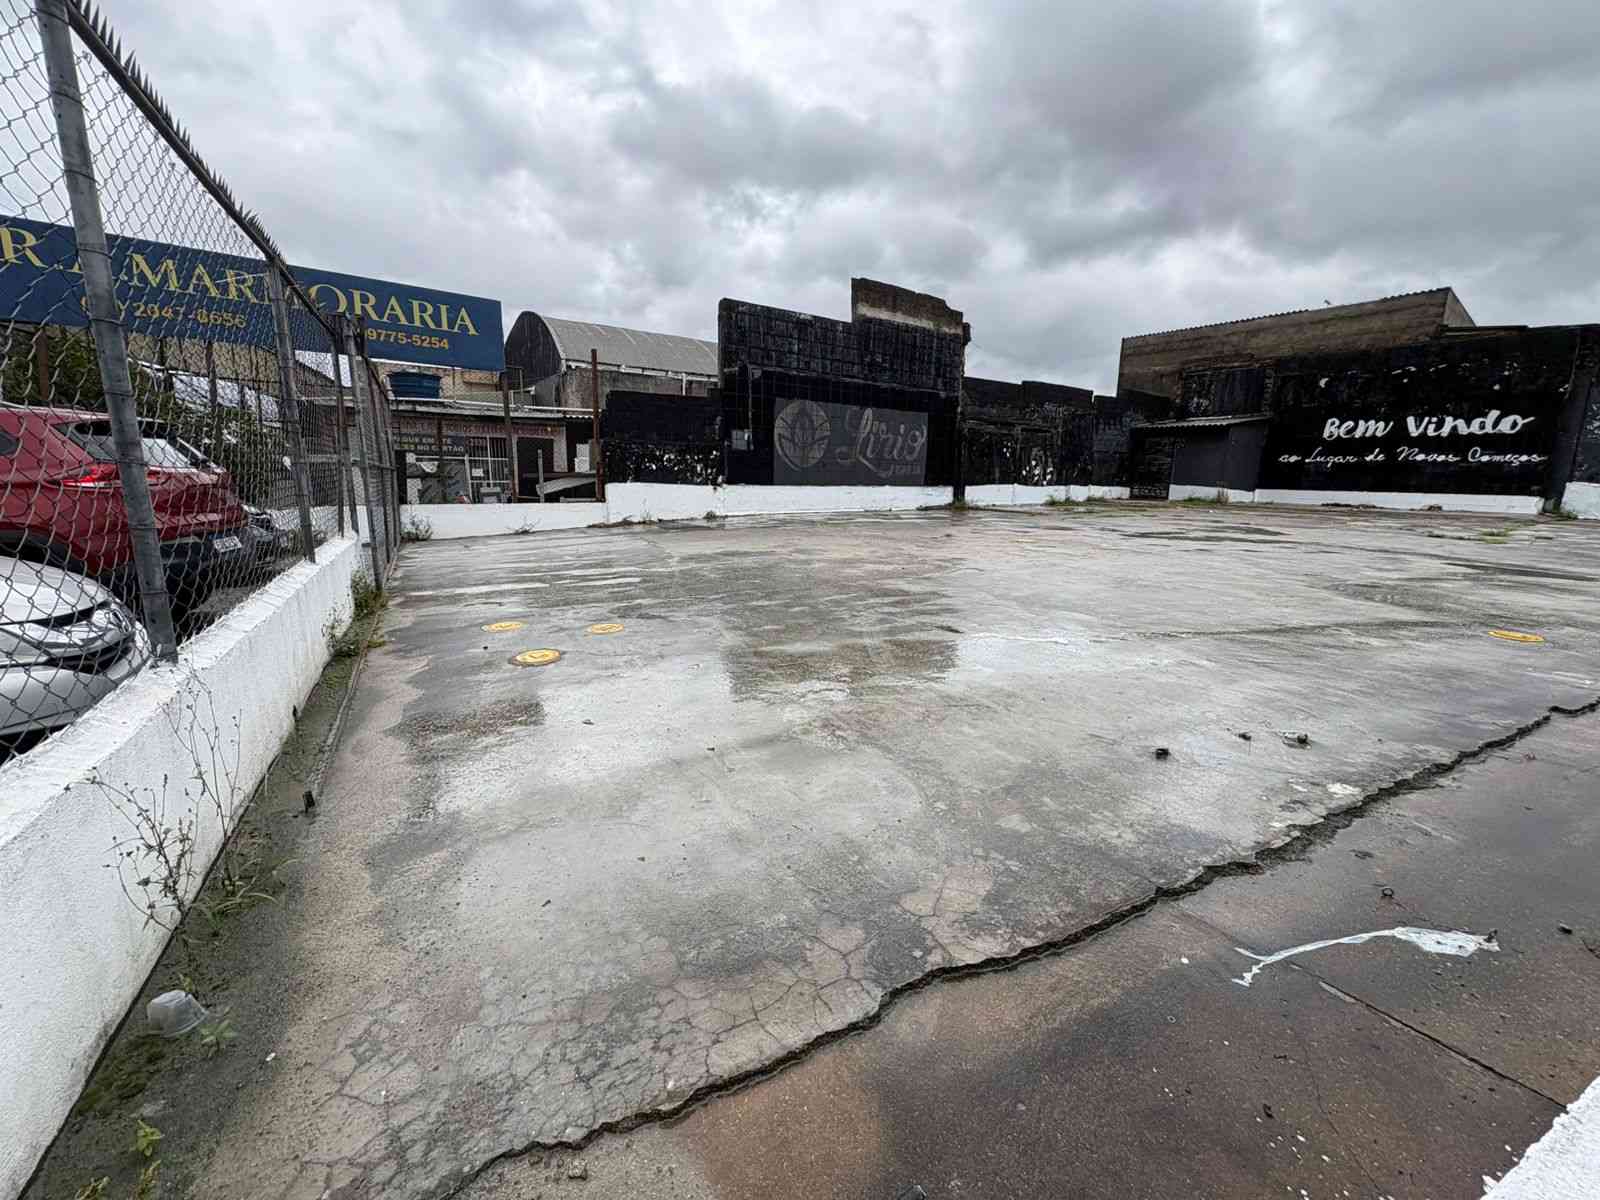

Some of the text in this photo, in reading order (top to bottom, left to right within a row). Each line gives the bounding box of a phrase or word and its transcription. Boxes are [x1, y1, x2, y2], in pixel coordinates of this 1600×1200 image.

[1322, 409, 1535, 440] Bem Vindo
[1304, 446, 1358, 468] Lugar
[1364, 447, 1386, 463] de
